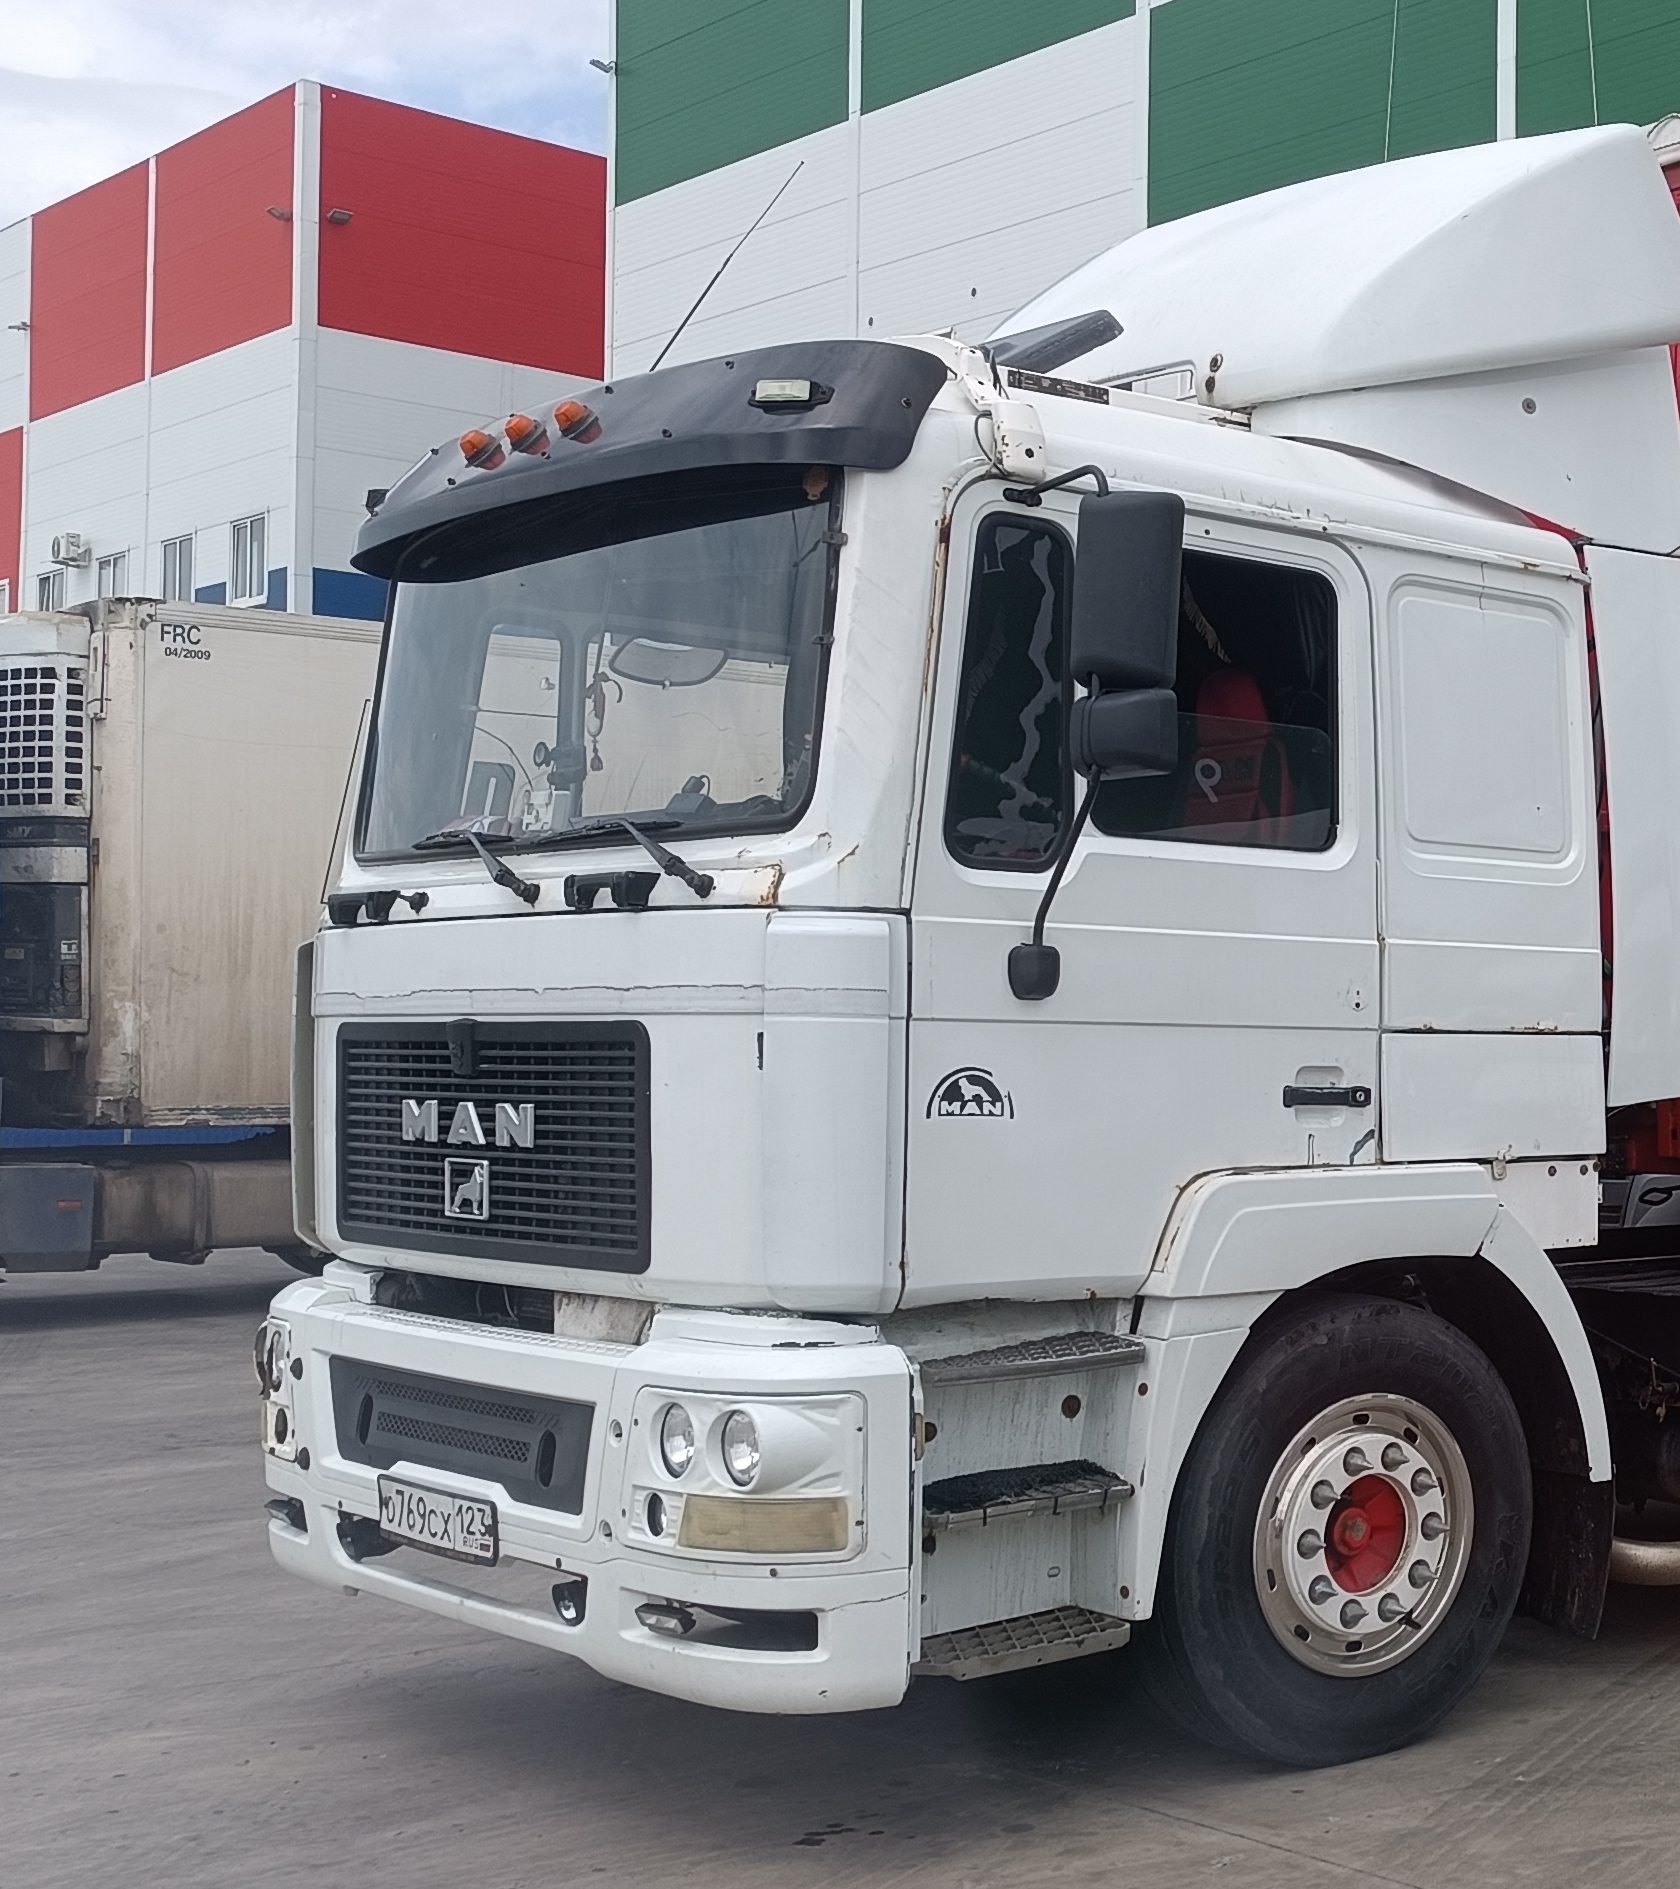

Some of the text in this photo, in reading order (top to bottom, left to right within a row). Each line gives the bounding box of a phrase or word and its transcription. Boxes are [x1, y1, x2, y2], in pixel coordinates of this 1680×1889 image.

[160, 623, 201, 645] FRC
[164, 647, 211, 660] 04/2009
[940, 1100, 1002, 1115] MAN
[401, 1099, 535, 1148] MAN
[462, 1536, 480, 1549] RUS
